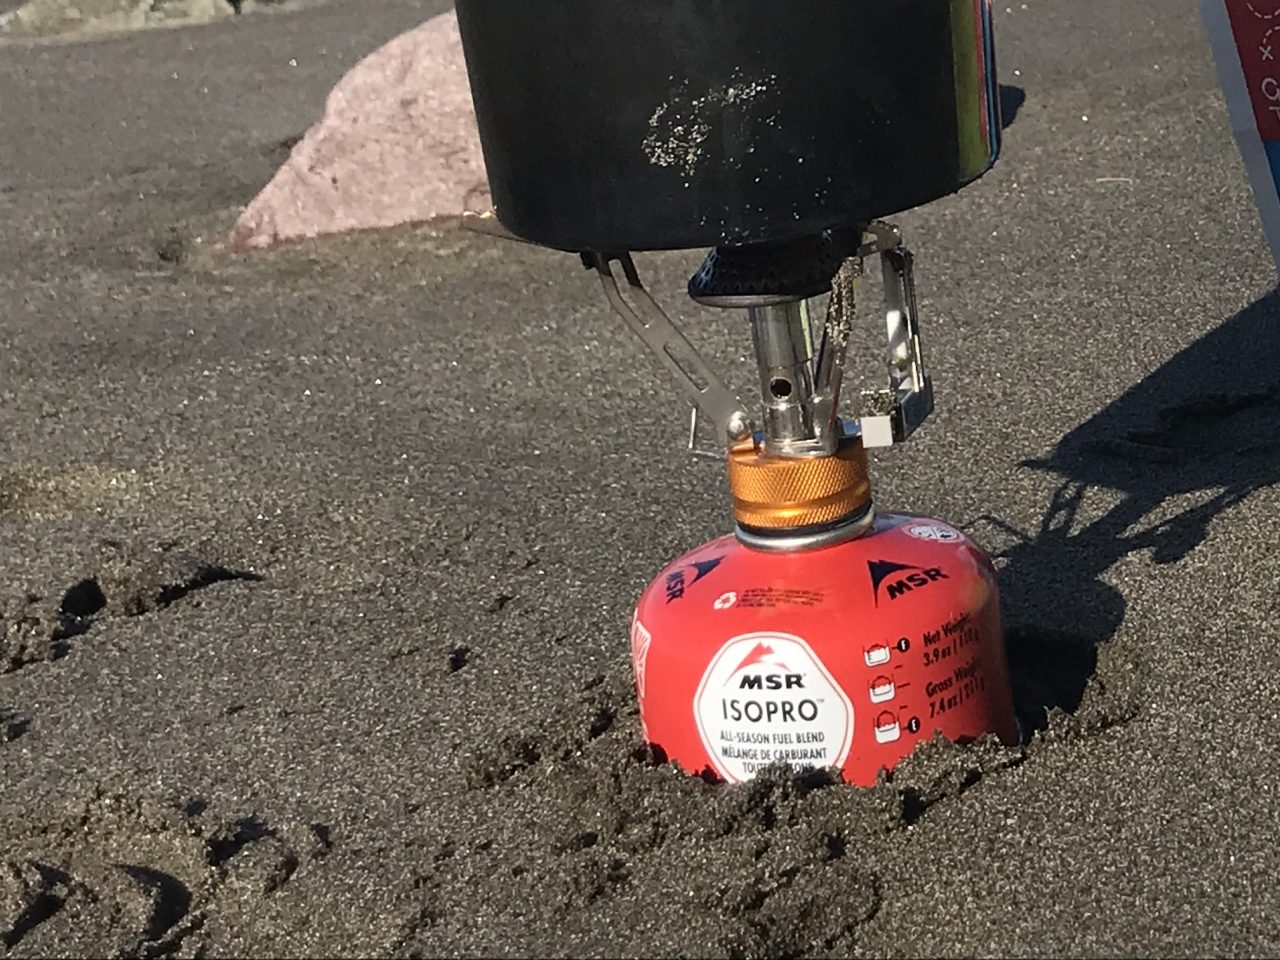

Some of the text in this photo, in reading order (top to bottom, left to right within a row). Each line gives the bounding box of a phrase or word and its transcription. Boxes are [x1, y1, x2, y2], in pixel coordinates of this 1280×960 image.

[666, 570, 685, 604] MSR
[886, 567, 950, 600] MSR
[923, 647, 940, 667] 3.9
[739, 673, 806, 690] MSR
[925, 677, 954, 698] Gross
[722, 698, 818, 722] ISOPRO
[929, 697, 946, 719] 7.4
[720, 729, 825, 744] ALL-SEASON FUEL BLEND
[761, 749, 771, 760] DE
[773, 747, 827, 760] CARBURANT
